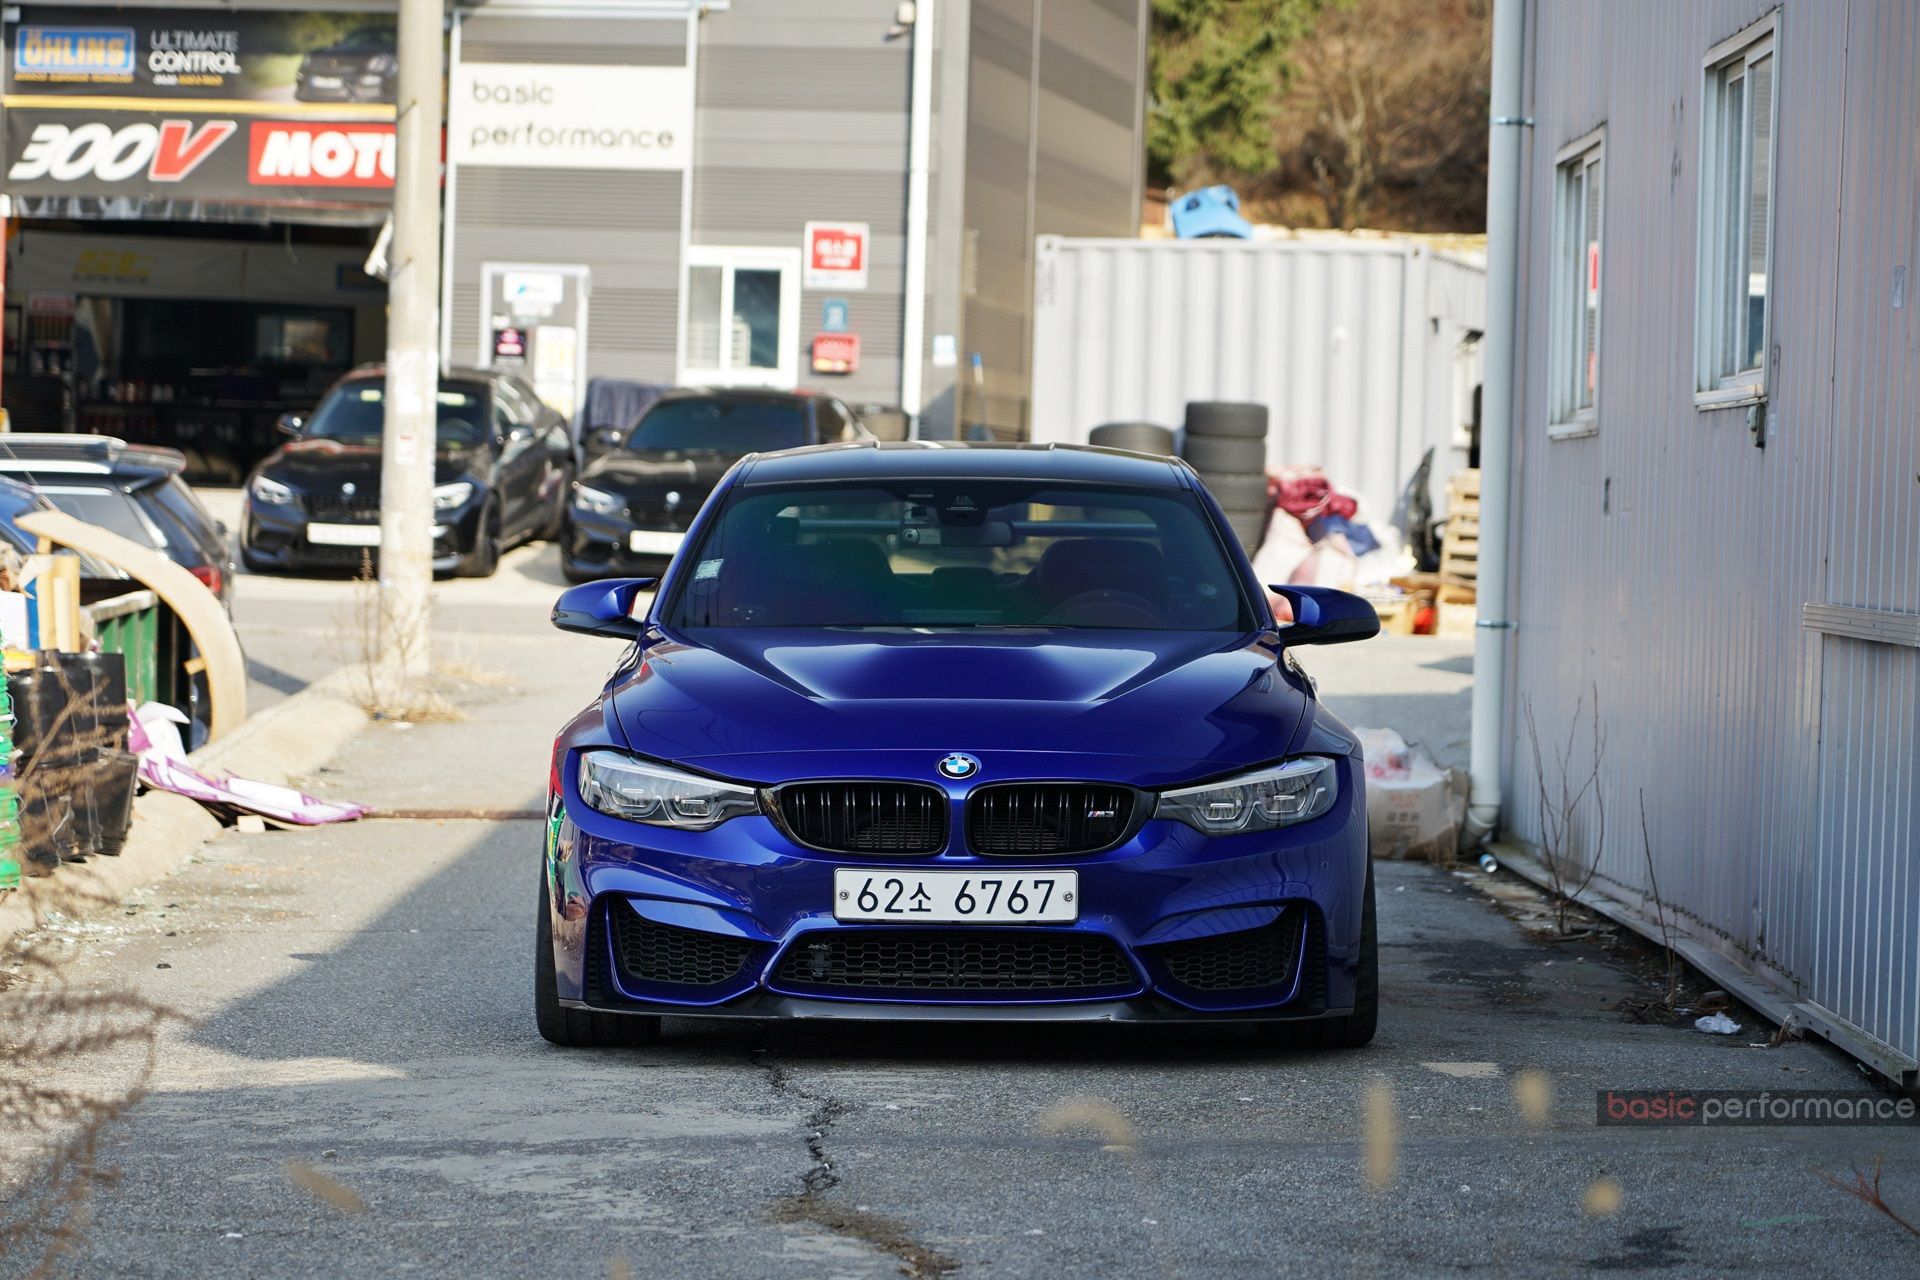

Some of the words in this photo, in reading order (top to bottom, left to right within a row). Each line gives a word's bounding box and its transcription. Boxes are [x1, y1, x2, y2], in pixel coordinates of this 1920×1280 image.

[24, 28, 127, 66] ÖHLINS
[150, 30, 239, 51] ULTIMATE
[148, 50, 241, 74] CONTROL
[472, 80, 555, 105] basic
[8, 119, 238, 182] 300V
[470, 122, 675, 149] performance
[258, 130, 398, 179] MOT
[857, 877, 931, 913] 62소
[954, 879, 1055, 915] 6767
